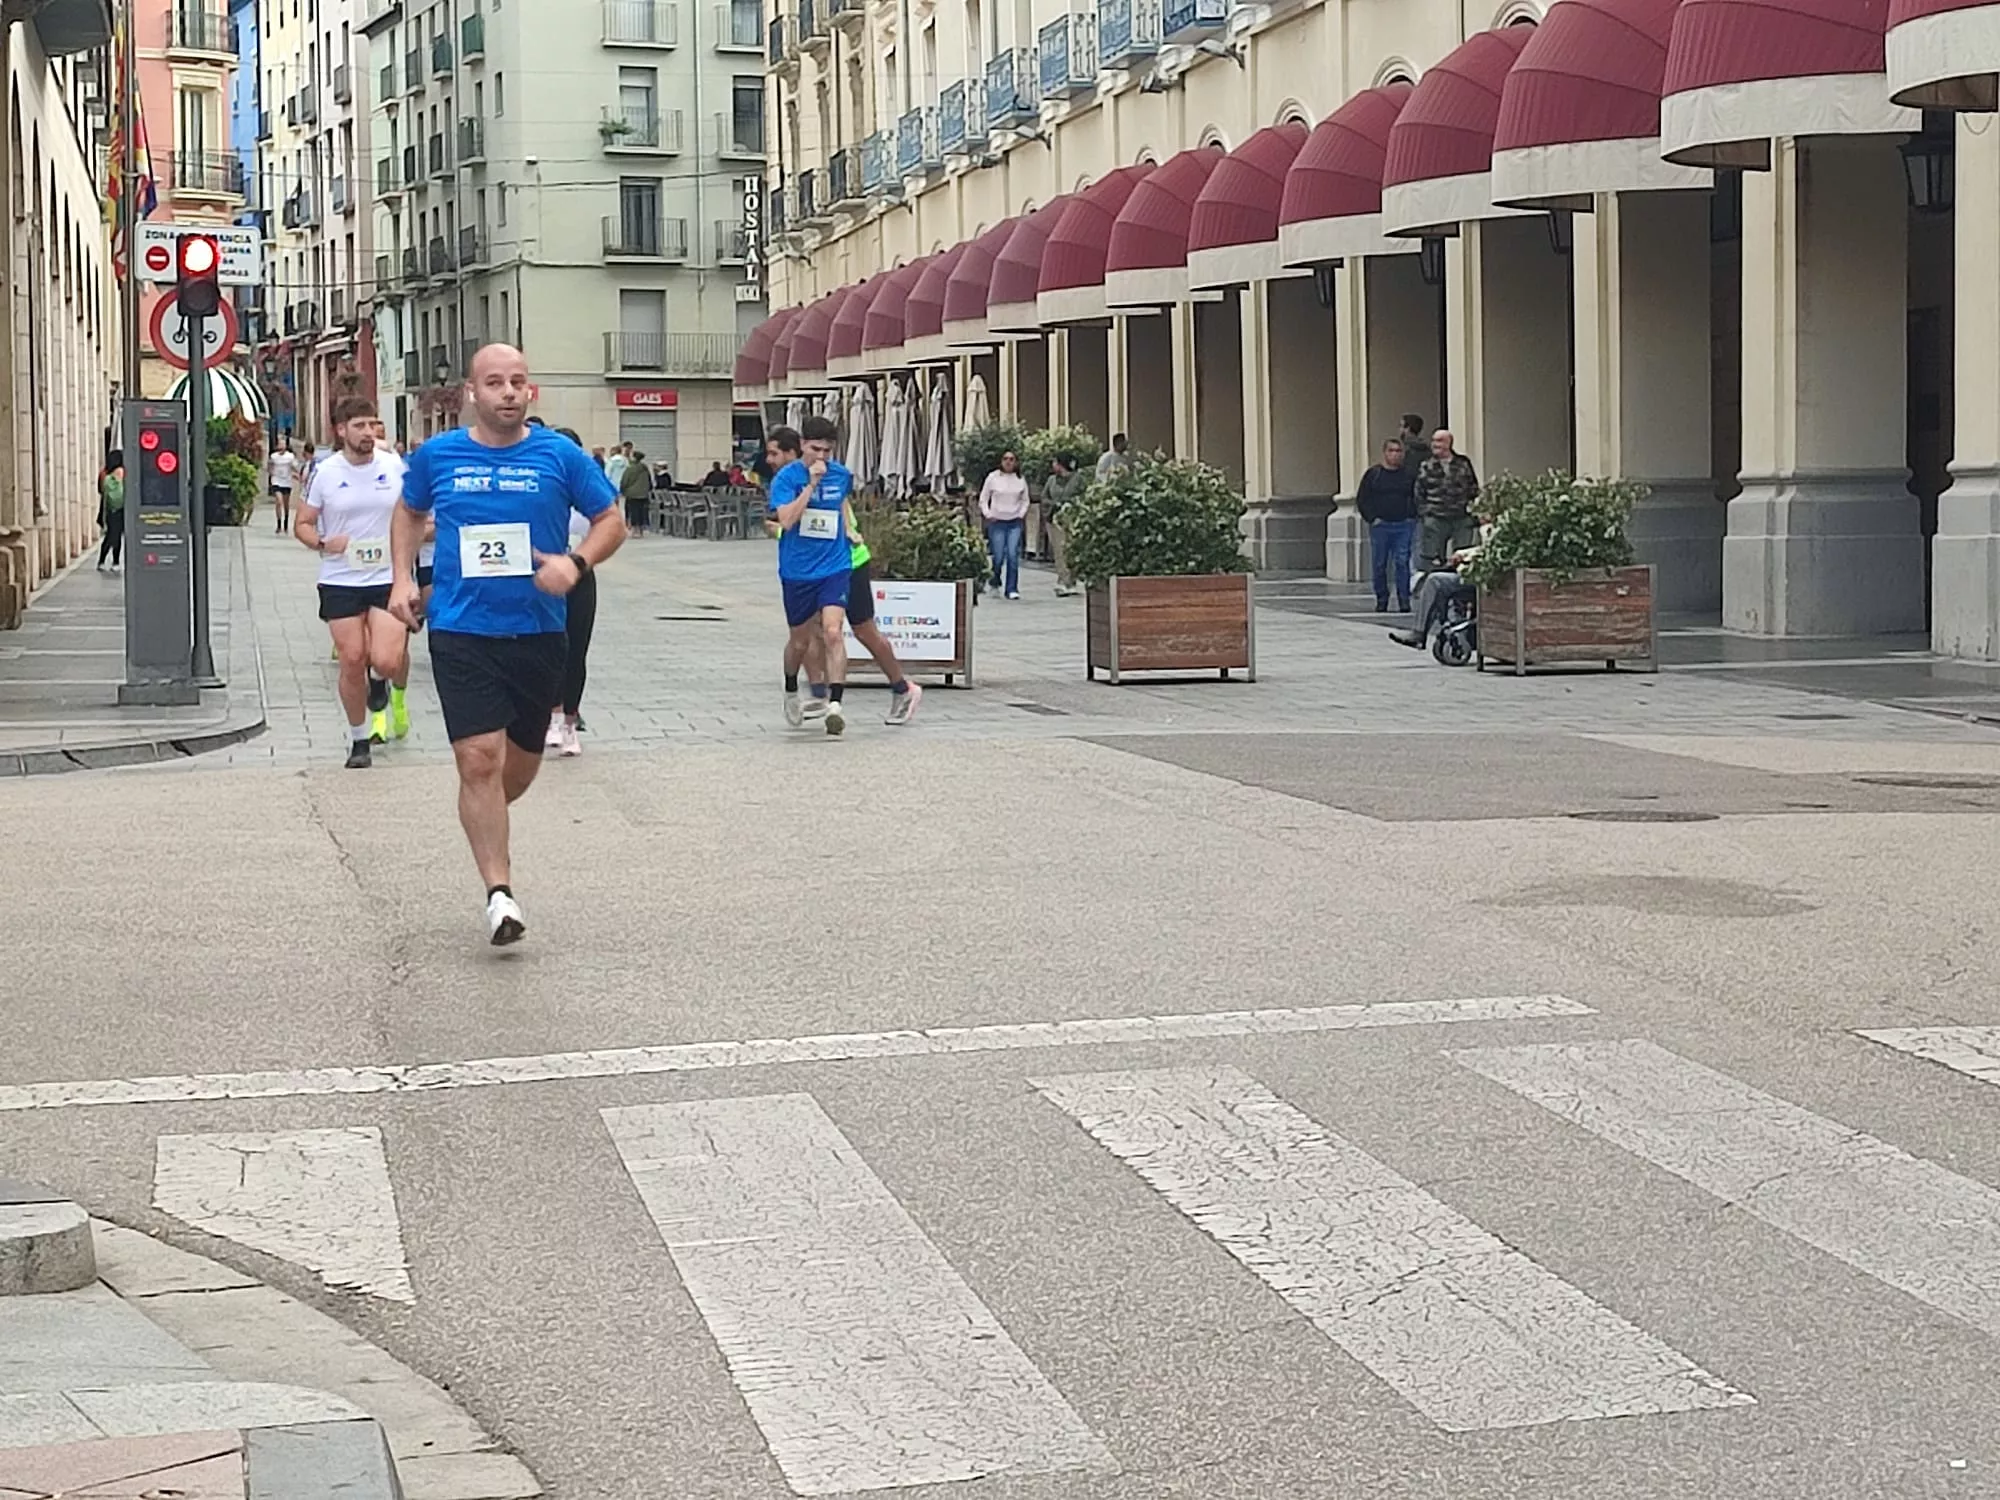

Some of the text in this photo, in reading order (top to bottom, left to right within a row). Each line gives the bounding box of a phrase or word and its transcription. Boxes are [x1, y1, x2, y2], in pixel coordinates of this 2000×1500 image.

[744, 176, 759, 280] HOSTAL
[633, 393, 661, 403] GAES
[479, 541, 506, 559] 23
